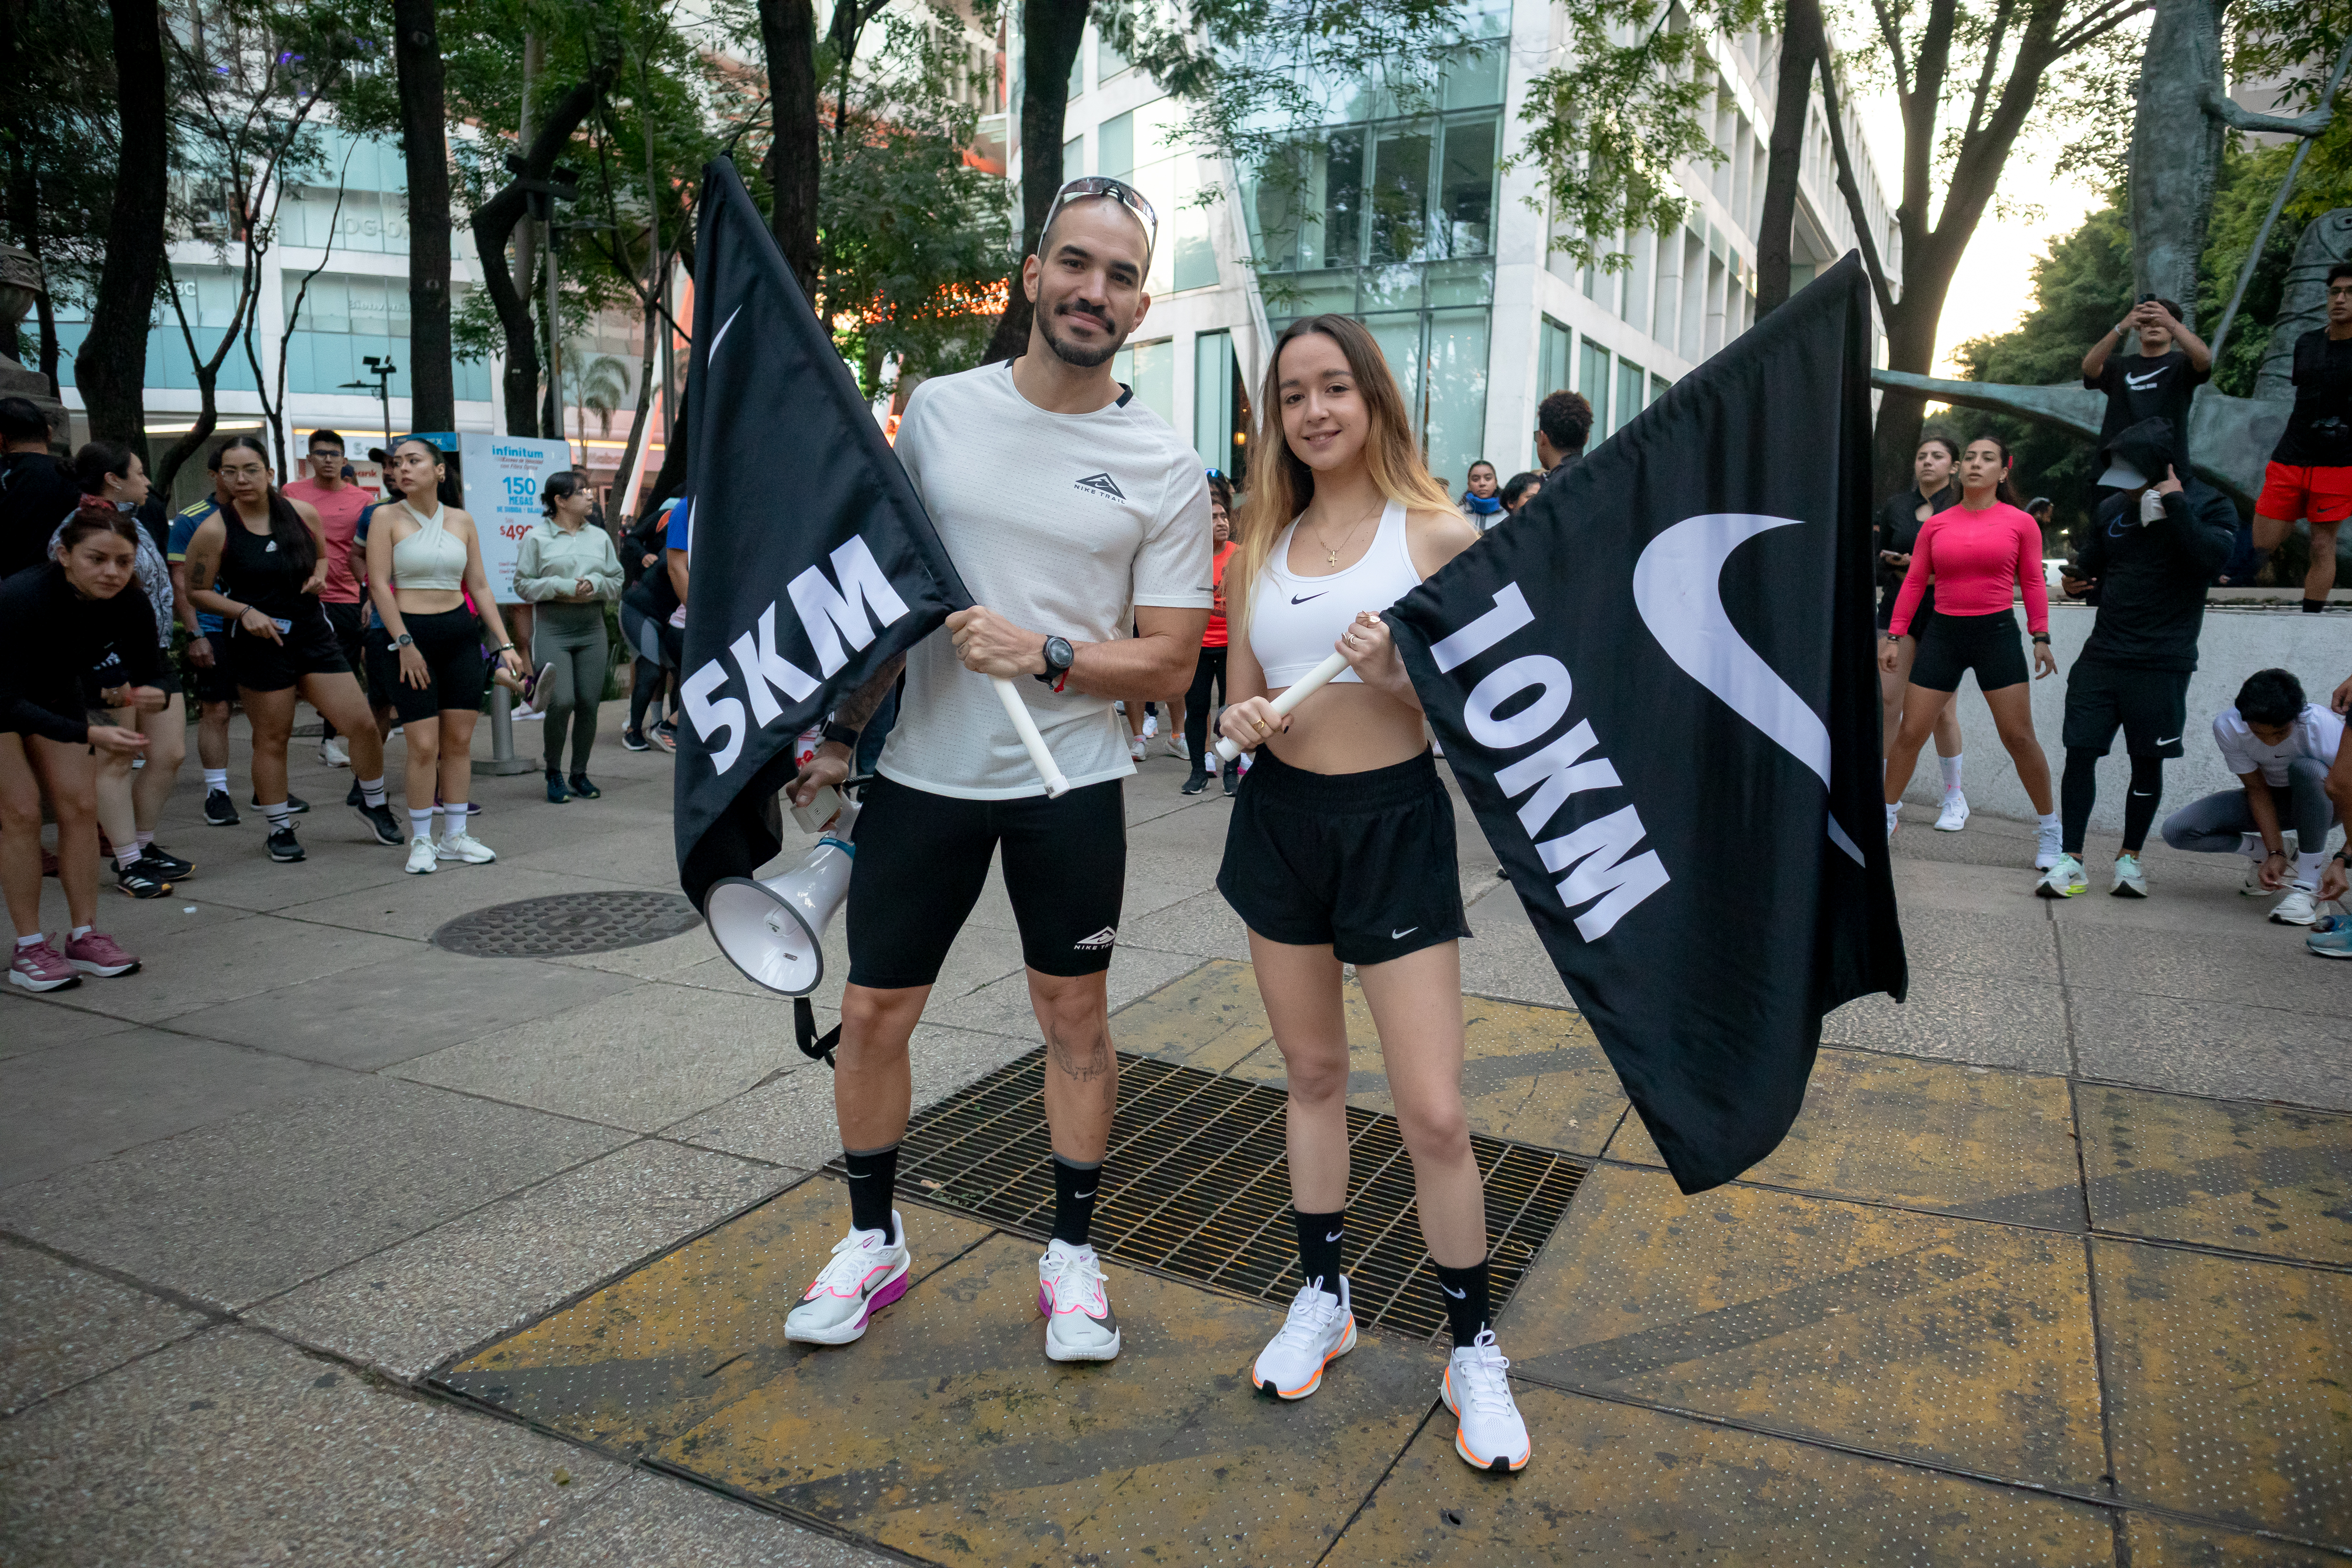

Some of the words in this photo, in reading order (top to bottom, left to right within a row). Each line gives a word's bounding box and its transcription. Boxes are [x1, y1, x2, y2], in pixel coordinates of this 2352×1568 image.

[493, 445, 543, 458] infinitum
[503, 477, 536, 495] 150
[1074, 484, 1096, 494] NIKE
[1100, 492, 1125, 504] TRAIL
[509, 496, 533, 505] MEGAS
[680, 534, 910, 776] 5KM
[1430, 581, 1670, 943] 10KM
